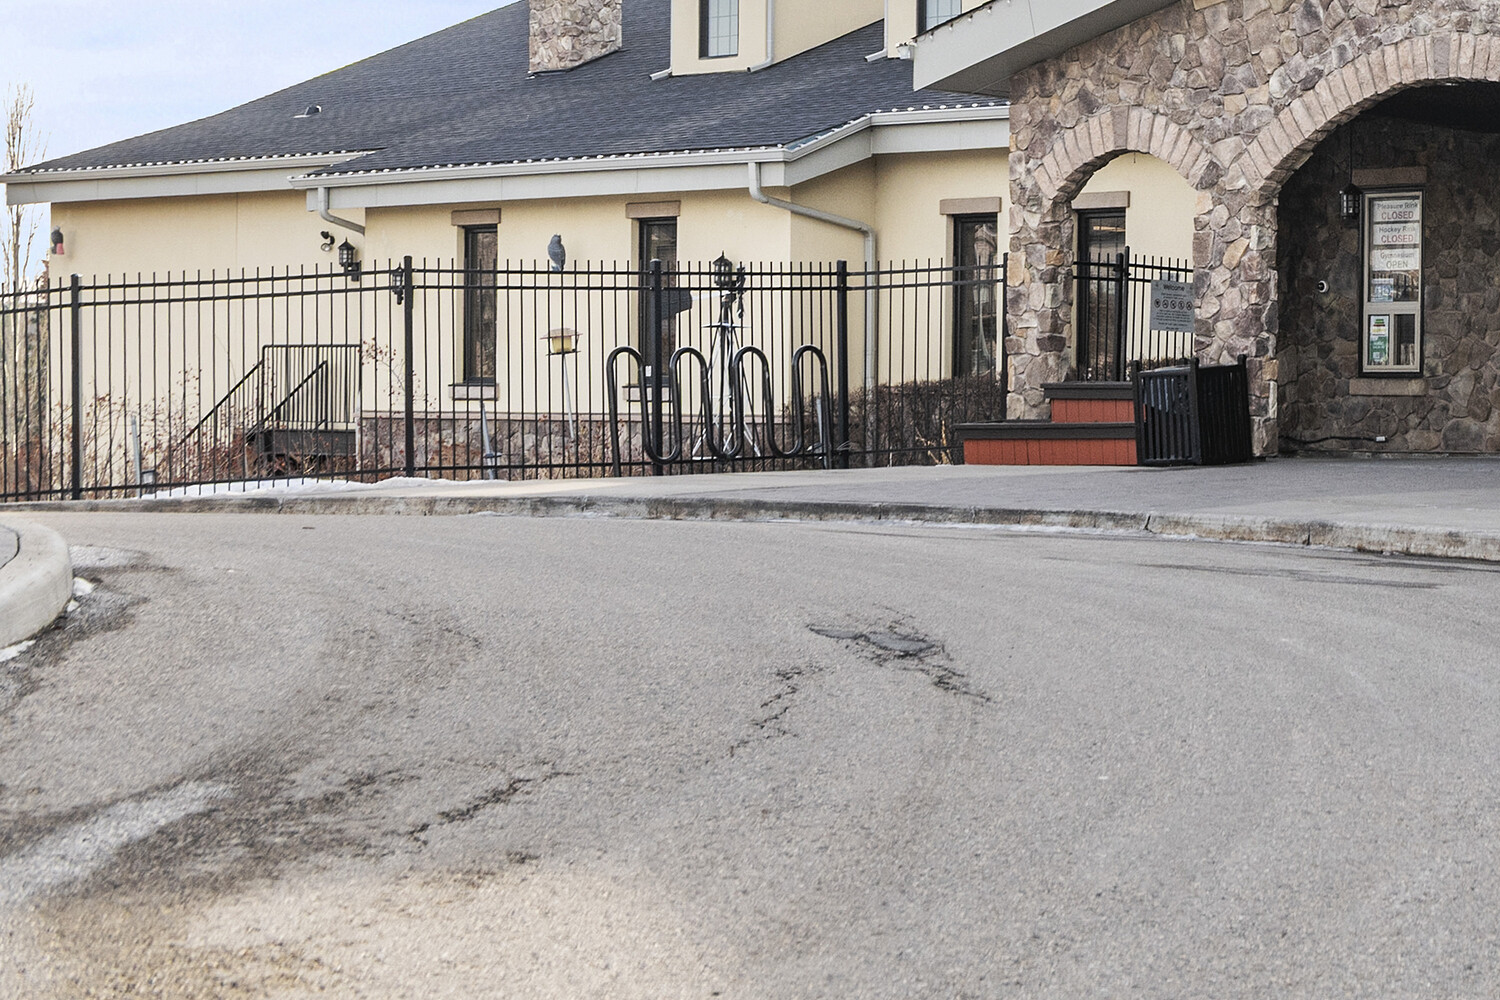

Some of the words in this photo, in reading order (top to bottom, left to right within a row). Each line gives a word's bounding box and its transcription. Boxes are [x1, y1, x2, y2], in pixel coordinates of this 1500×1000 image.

[1381, 211, 1414, 220] CLOSED
[1381, 234, 1414, 243] CLOSED
[1386, 260, 1408, 269] OPEN
